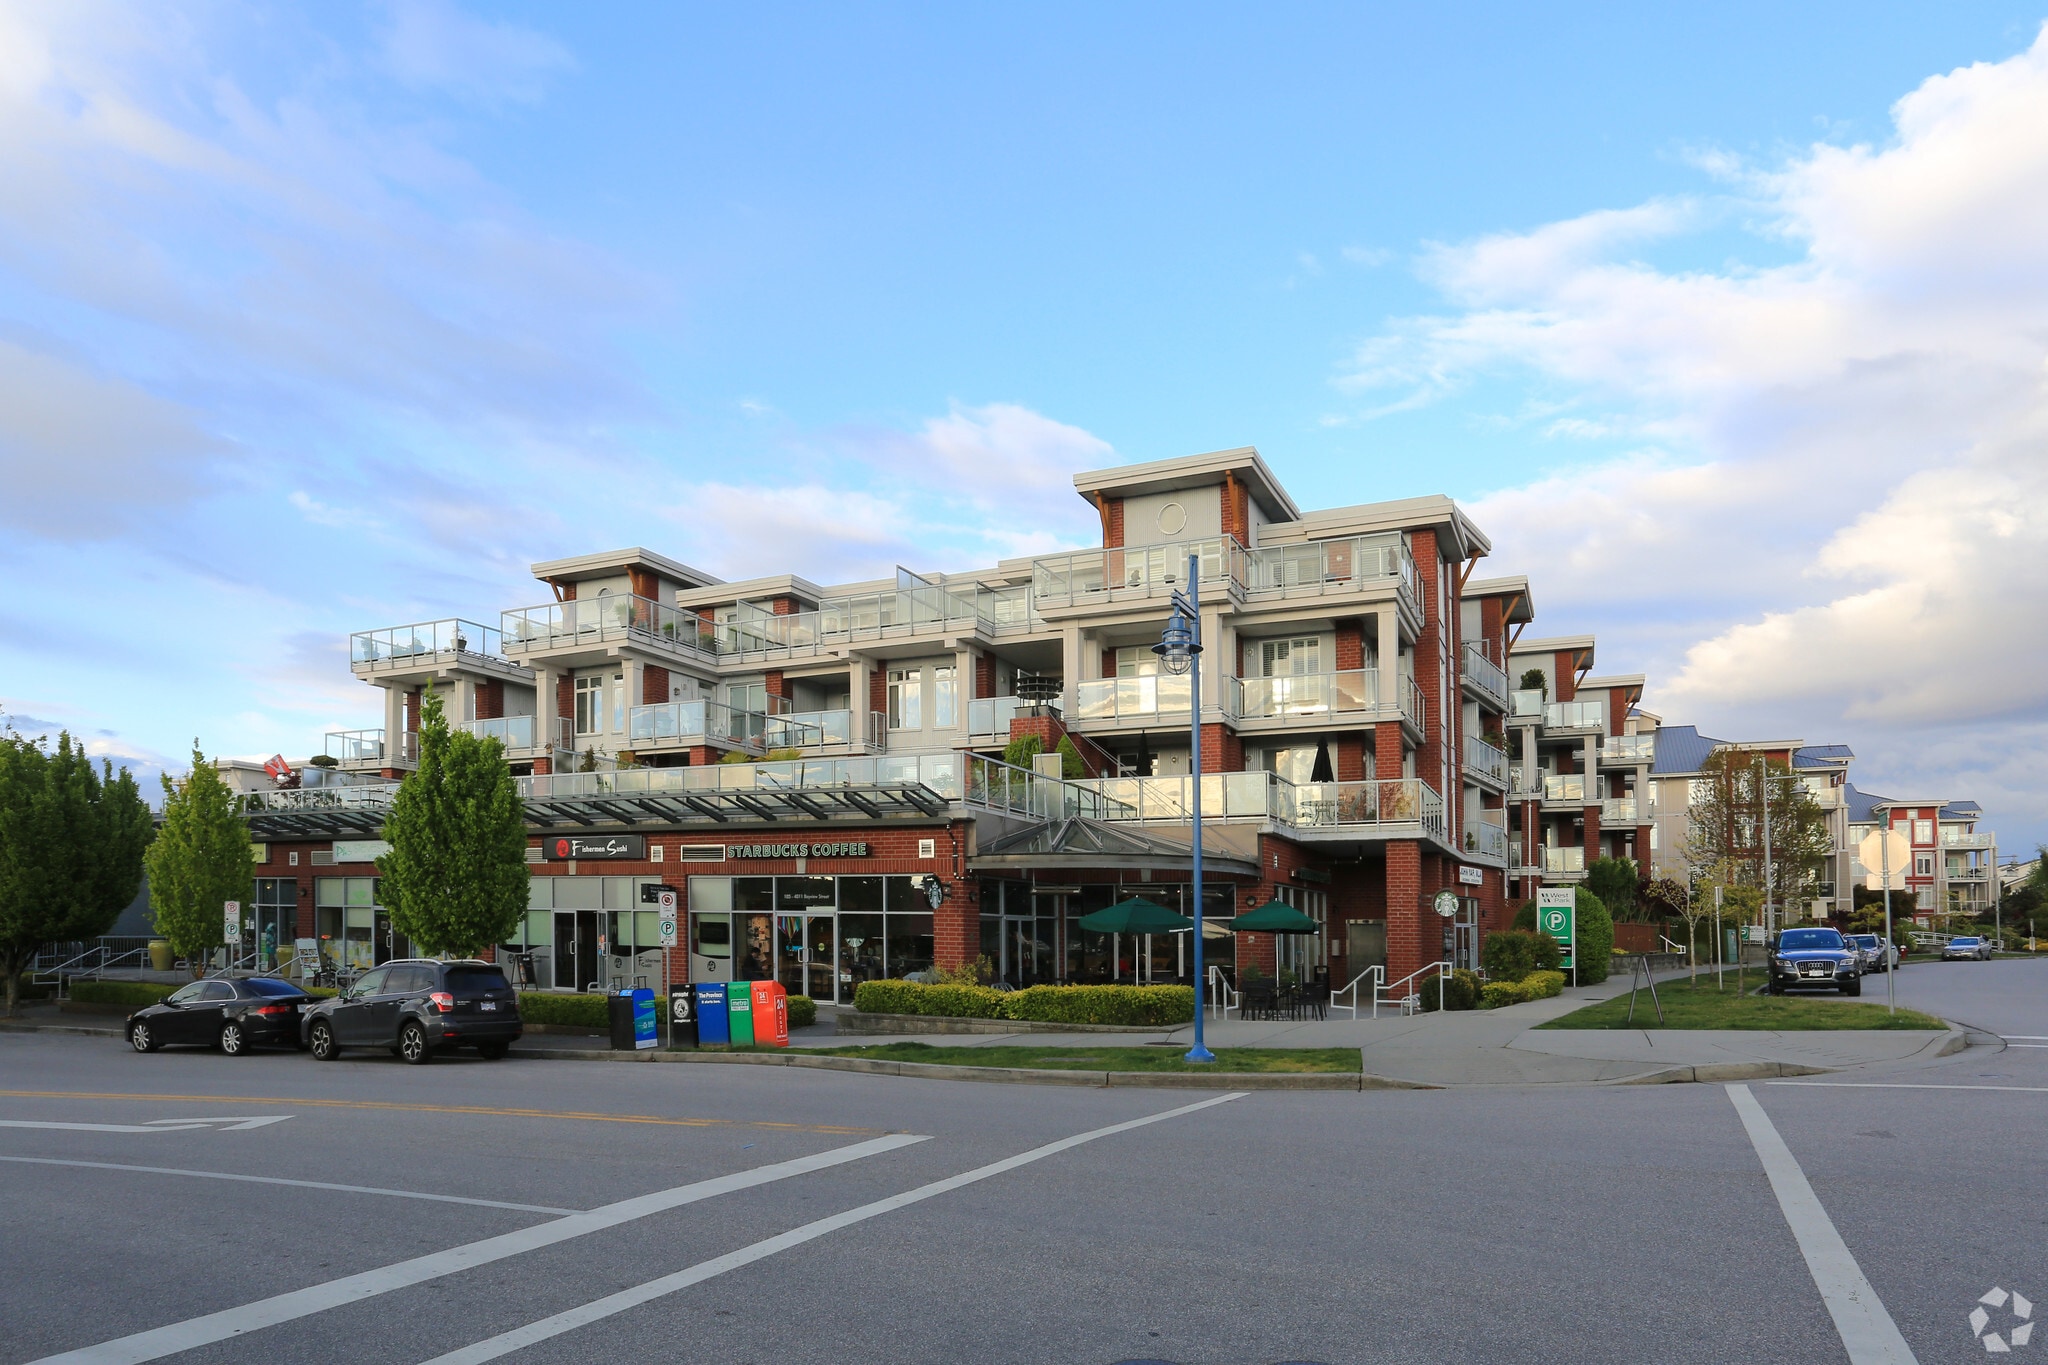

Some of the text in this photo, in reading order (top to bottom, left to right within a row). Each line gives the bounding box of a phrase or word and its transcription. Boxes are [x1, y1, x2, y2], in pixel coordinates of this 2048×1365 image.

[571, 840, 628, 856] Fishermen Sushi
[727, 842, 867, 858] STARBUCKS COFFEE
[665, 923, 672, 933] P
[1551, 913, 1563, 929] P
[776, 998, 784, 1010] 24
